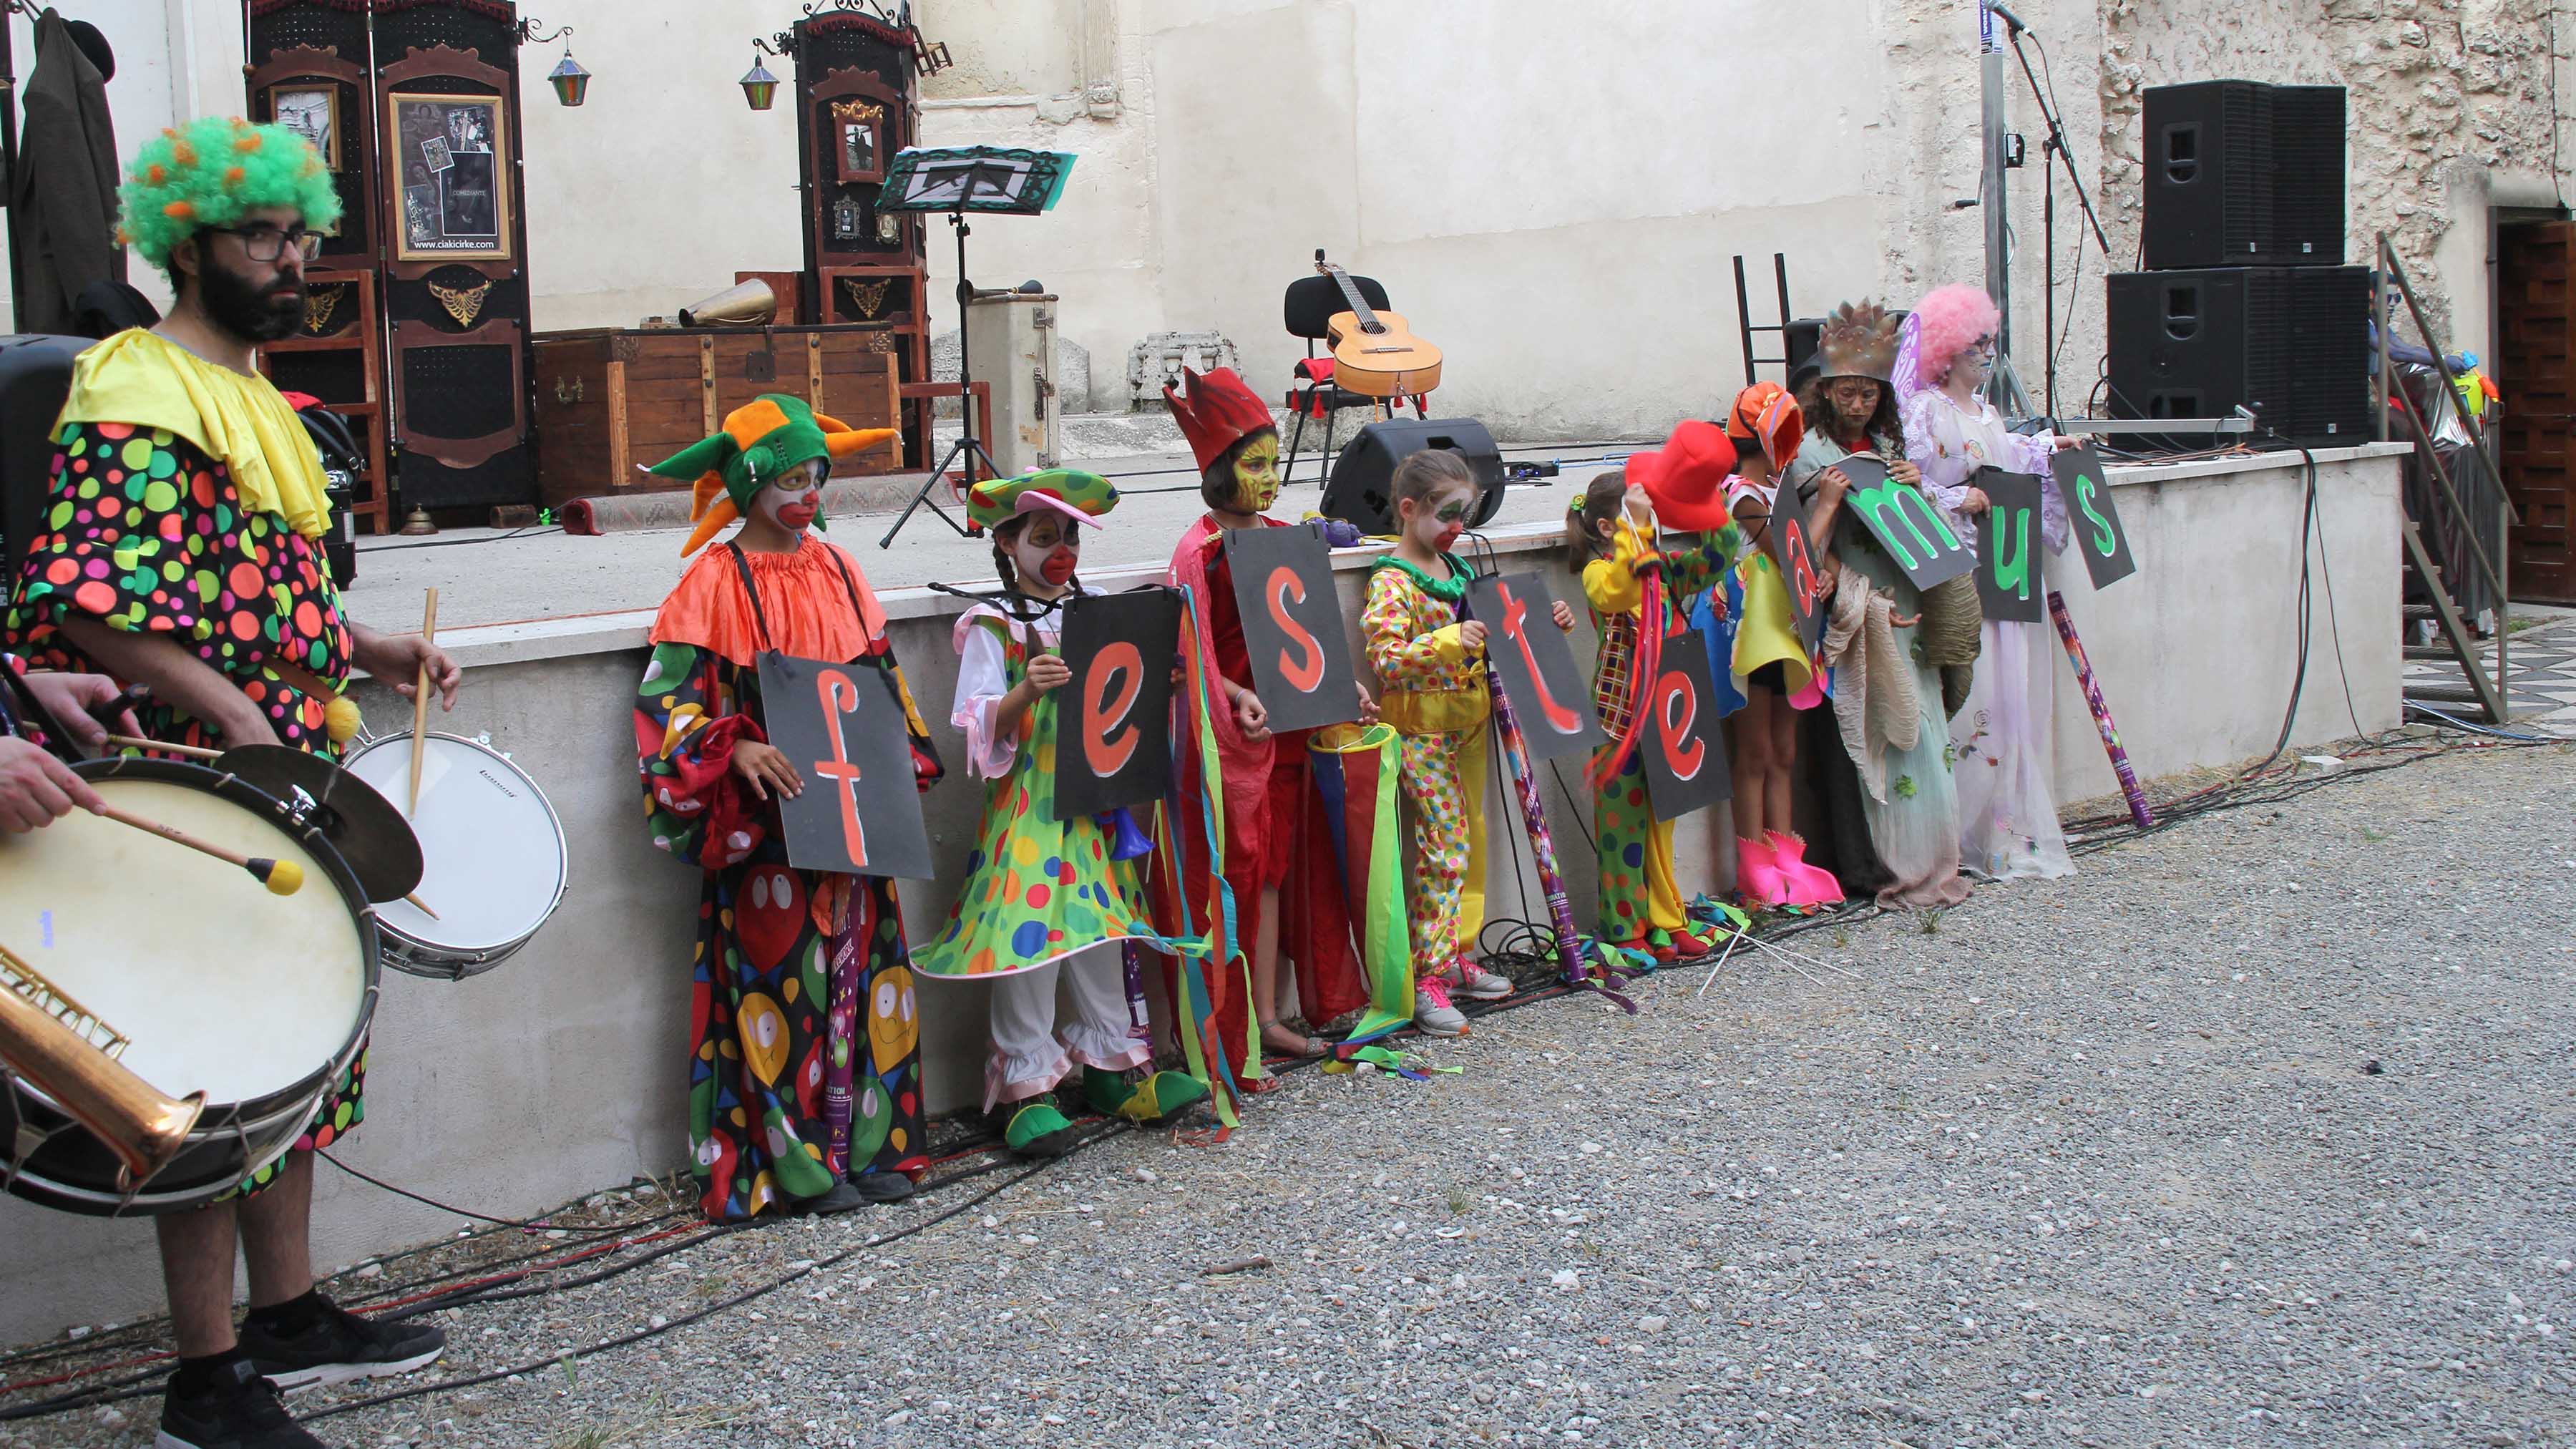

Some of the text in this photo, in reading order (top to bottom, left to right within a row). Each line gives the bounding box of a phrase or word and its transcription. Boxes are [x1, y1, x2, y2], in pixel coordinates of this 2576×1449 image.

[414, 240, 494, 249] www.ciakicirke.com
[1785, 517, 1818, 618] a
[1847, 479, 1962, 570] m
[1991, 506, 2031, 601] u
[2075, 474, 2115, 557] s
[1266, 566, 1325, 693] s
[1497, 581, 1584, 735] t
[1082, 642, 1144, 778] e
[1655, 669, 1705, 781] e
[814, 668, 863, 867] f
